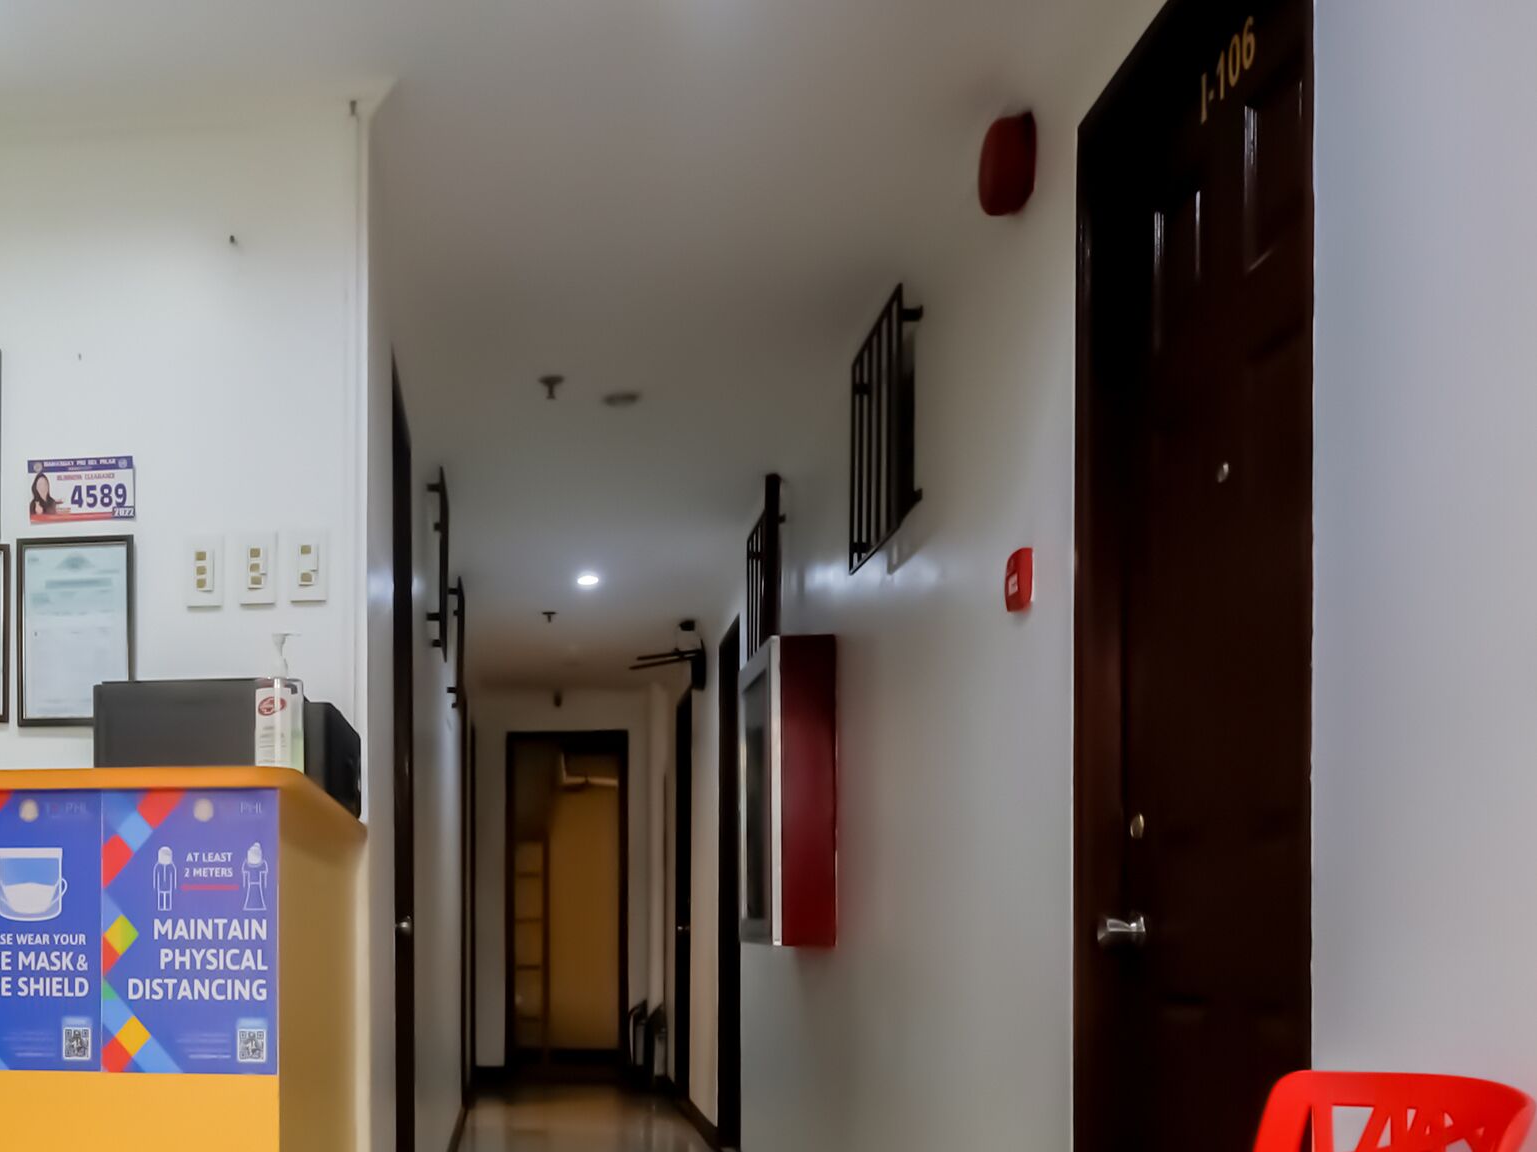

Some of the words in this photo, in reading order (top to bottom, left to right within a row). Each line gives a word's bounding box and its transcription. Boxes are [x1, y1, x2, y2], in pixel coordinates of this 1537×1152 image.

[71, 483, 127, 508] 4589
[113, 508, 134, 517] 2022
[186, 852, 200, 862] AT
[202, 852, 233, 862] LEAST
[184, 867, 190, 877] 2
[193, 867, 233, 877] METERS
[16, 933, 50, 945] WEAR
[53, 934, 86, 945] YOUR
[153, 918, 267, 940] MAINTAIN
[160, 948, 268, 970] PHYSICAL
[17, 977, 89, 997] SHIELD
[127, 977, 267, 1001] DISTANCING
